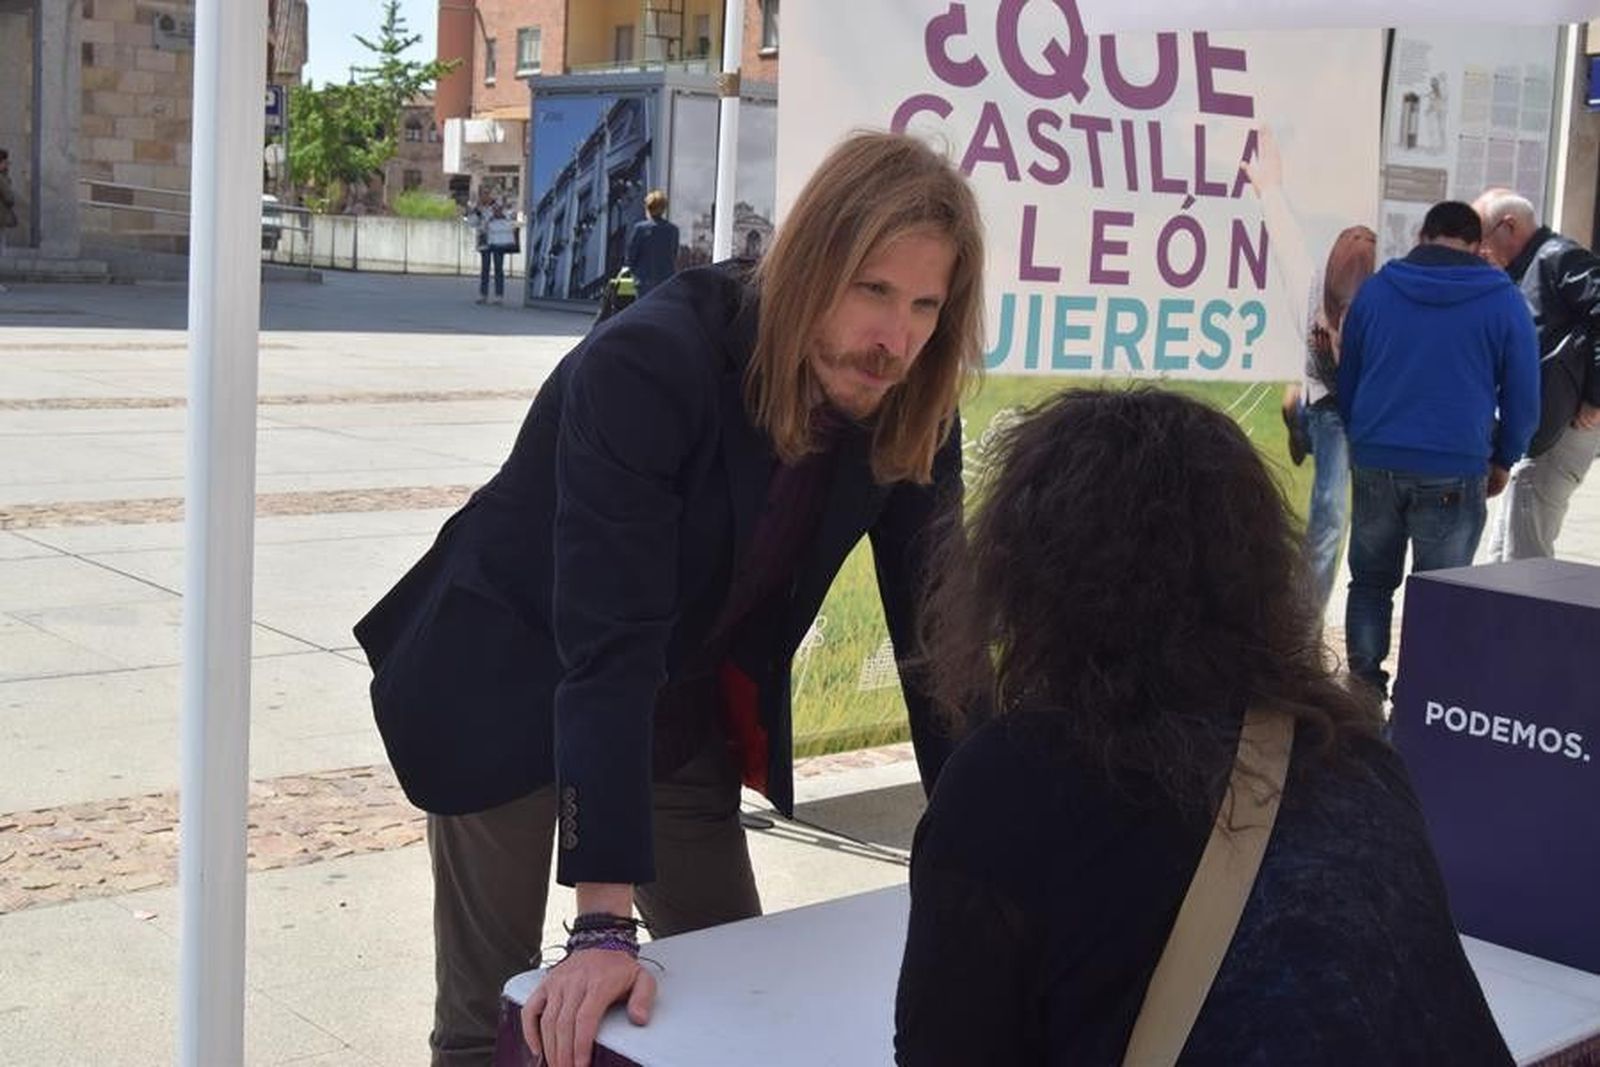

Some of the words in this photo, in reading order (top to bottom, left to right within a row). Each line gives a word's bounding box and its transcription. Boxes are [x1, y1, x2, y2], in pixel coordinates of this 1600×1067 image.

[1018, 194, 1269, 290] LEÓN
[981, 292, 1267, 370] UIERES?
[1425, 700, 1591, 762] PODEMOS.
